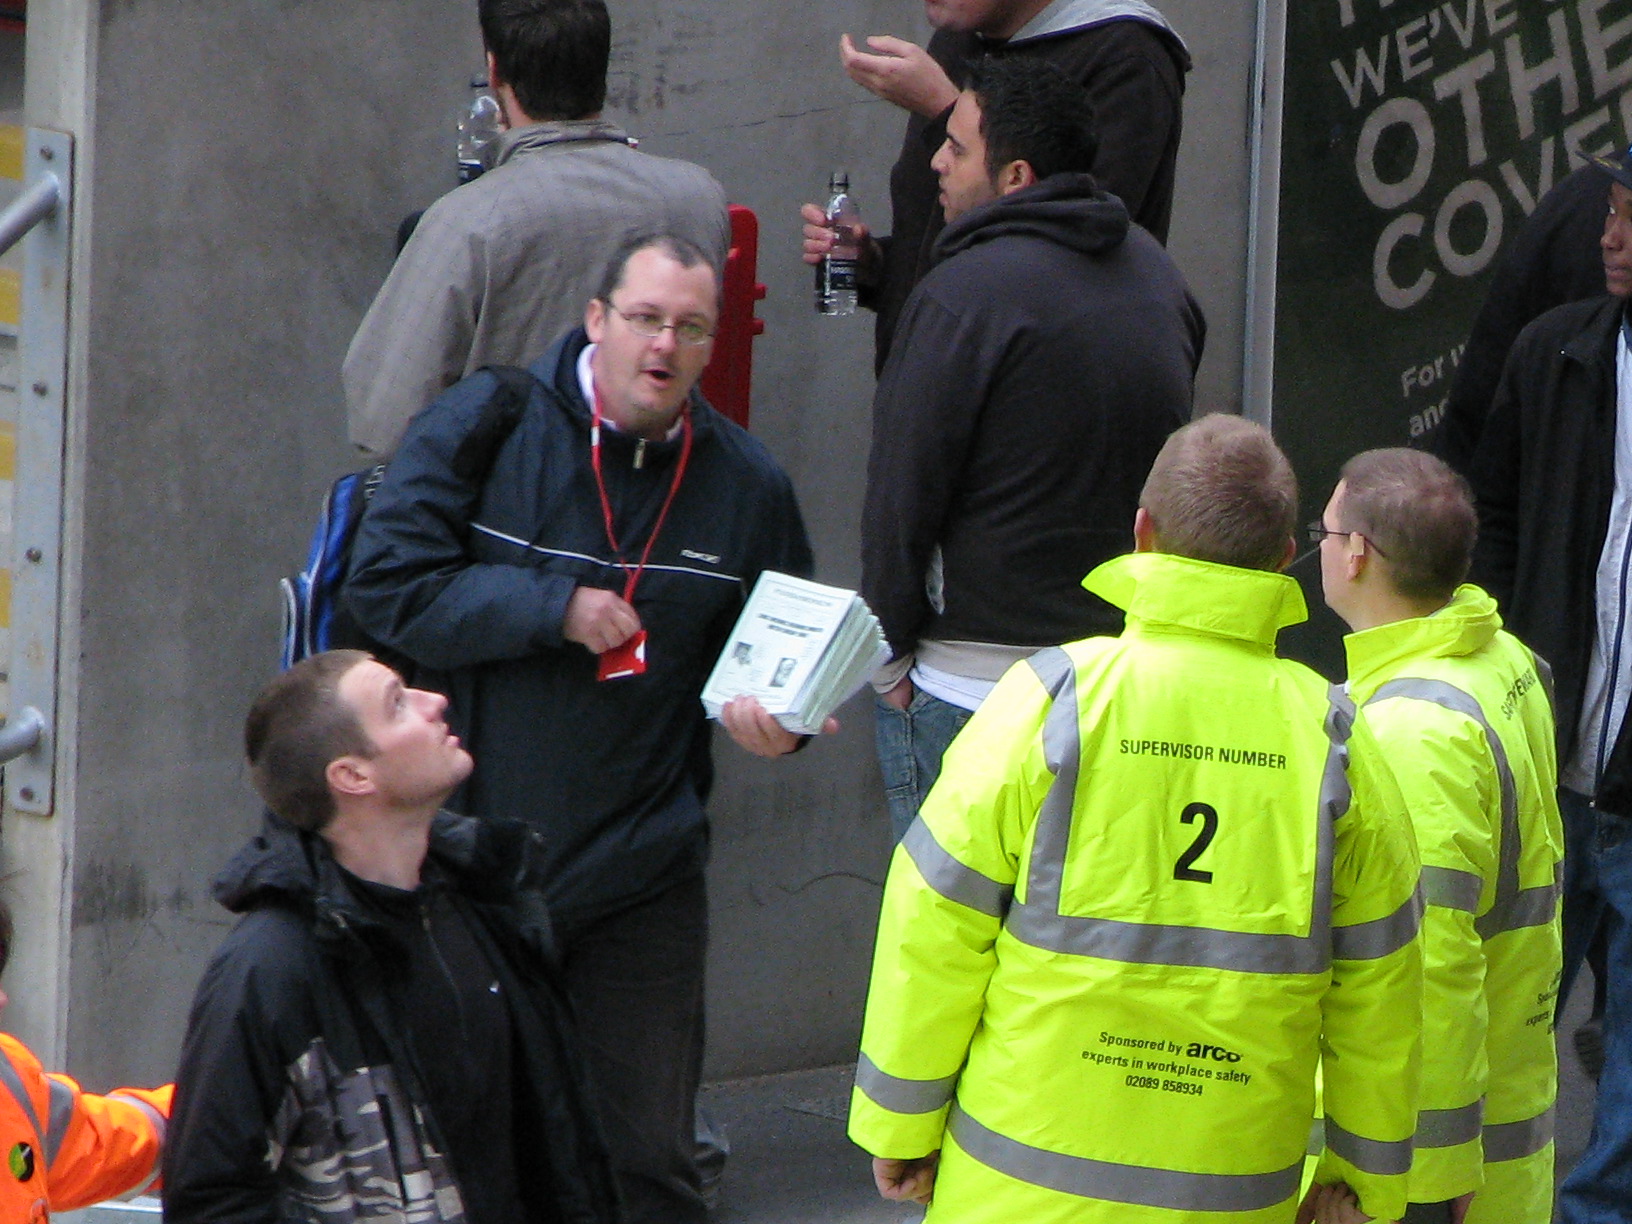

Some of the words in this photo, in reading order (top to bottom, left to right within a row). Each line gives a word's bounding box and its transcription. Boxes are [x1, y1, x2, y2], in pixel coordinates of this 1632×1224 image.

[1330, 0, 1519, 109] WE'VE
[1401, 356, 1444, 398] For
[1119, 739, 1214, 762] SUPERVISOR
[1218, 747, 1287, 770] NUMBER
[1173, 801, 1219, 884] 2
[1099, 1031, 1165, 1051] Sponsored
[1168, 1042, 1183, 1055] by
[1186, 1041, 1243, 1063] arco
[1081, 1049, 1129, 1068] experts
[1131, 1056, 1143, 1069] in
[1146, 1062, 1213, 1079] workplace
[1216, 1069, 1252, 1086] safety
